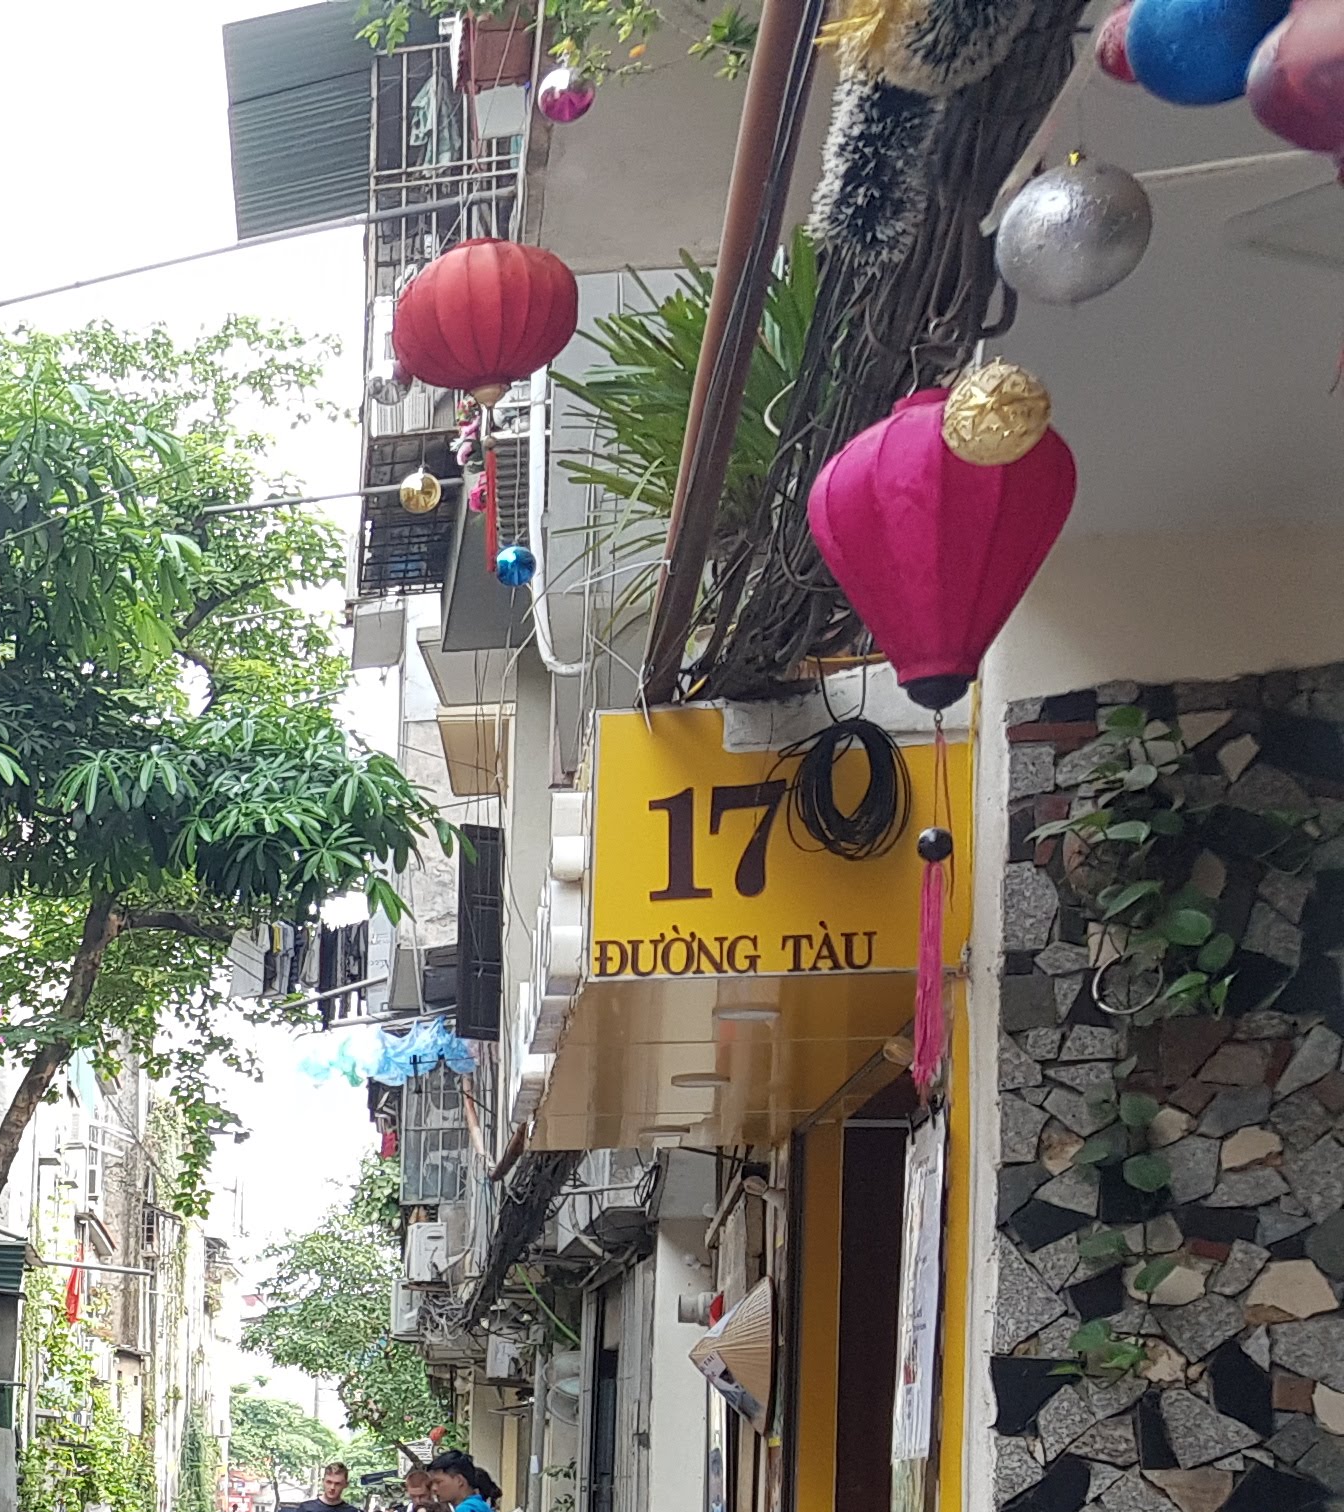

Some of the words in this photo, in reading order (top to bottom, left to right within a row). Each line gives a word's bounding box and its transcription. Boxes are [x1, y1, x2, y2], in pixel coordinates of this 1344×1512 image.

[648, 778, 787, 902] 17
[594, 924, 762, 978] ĐƯỜNG
[781, 920, 878, 973] TÀU
